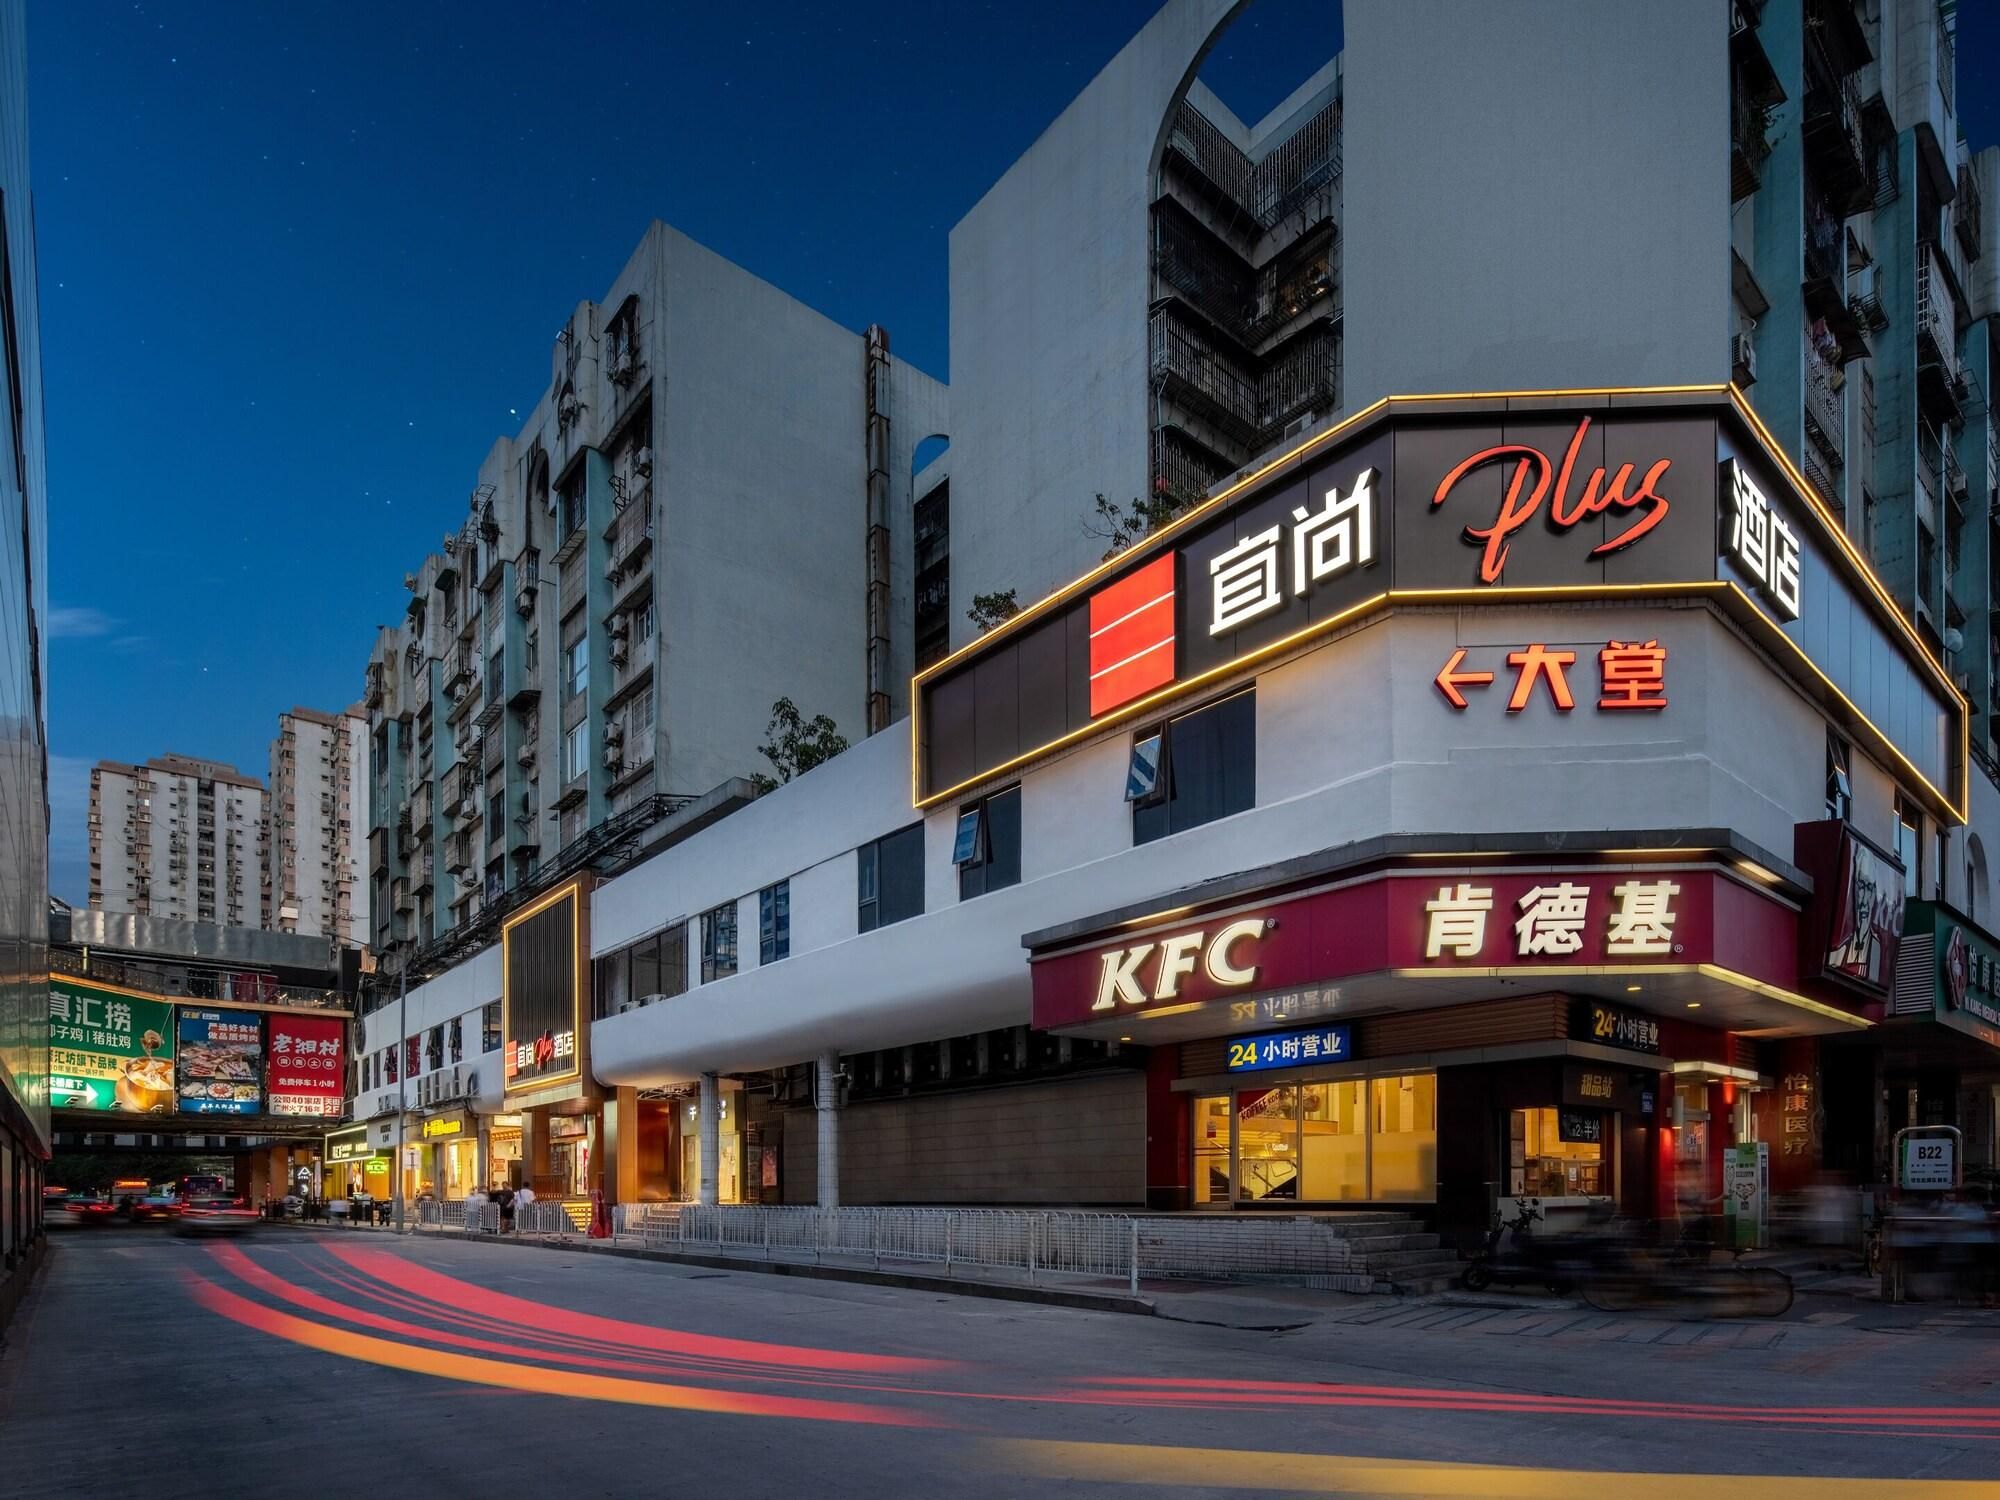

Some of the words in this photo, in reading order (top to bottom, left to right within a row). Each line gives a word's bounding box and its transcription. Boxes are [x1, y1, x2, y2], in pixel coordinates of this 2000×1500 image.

[1210, 467, 1376, 637] 宜尚
[1731, 457, 1801, 621] 酒店
[1506, 639, 1667, 711] 大堂
[1426, 881, 1680, 957] 肯德基
[1092, 919, 1265, 1010] KFC
[50, 991, 131, 1032] 真汇捞
[518, 1042, 534, 1068] 宜尚
[554, 1031, 574, 1058] 酒店
[324, 1105, 340, 1113] 2F
[1581, 1074, 1613, 1098] 甜品站
[1784, 1073, 1809, 1155] 怡康医疗
[1918, 1146, 1942, 1160] B22
